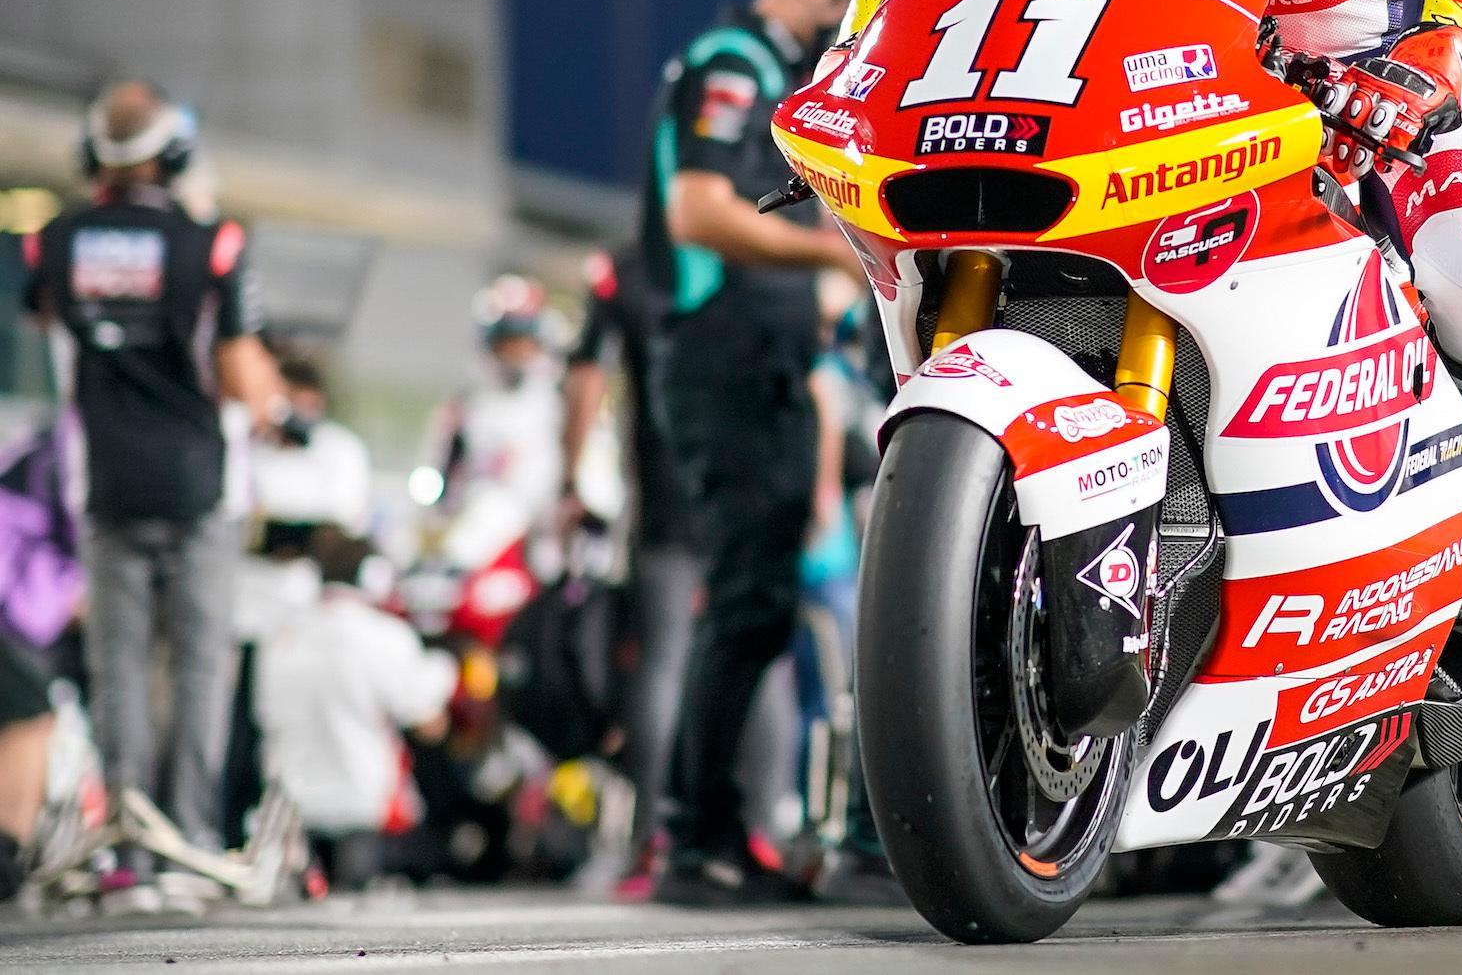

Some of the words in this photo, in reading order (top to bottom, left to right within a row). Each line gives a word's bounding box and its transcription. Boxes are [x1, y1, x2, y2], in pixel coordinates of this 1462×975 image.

[1126, 53, 1168, 72] uma
[1131, 65, 1184, 85] racing
[923, 114, 1010, 141] BOLD
[1119, 92, 1250, 133] Gigetta
[920, 138, 1028, 154] RIDERS
[1101, 135, 1281, 211] Antangin
[1154, 230, 1235, 264] PASCUCCI
[1248, 350, 1397, 424] FEDERAL
[1402, 336, 1431, 393] OIL
[1078, 443, 1164, 494] MOTO-TRON
[1404, 451, 1438, 478] FEDERAL
[1106, 563, 1131, 583] D
[1319, 592, 1416, 644] RACING
[1299, 677, 1354, 725] GS
[1241, 721, 1378, 817] BOLD
[1228, 773, 1371, 838] RIDERS
